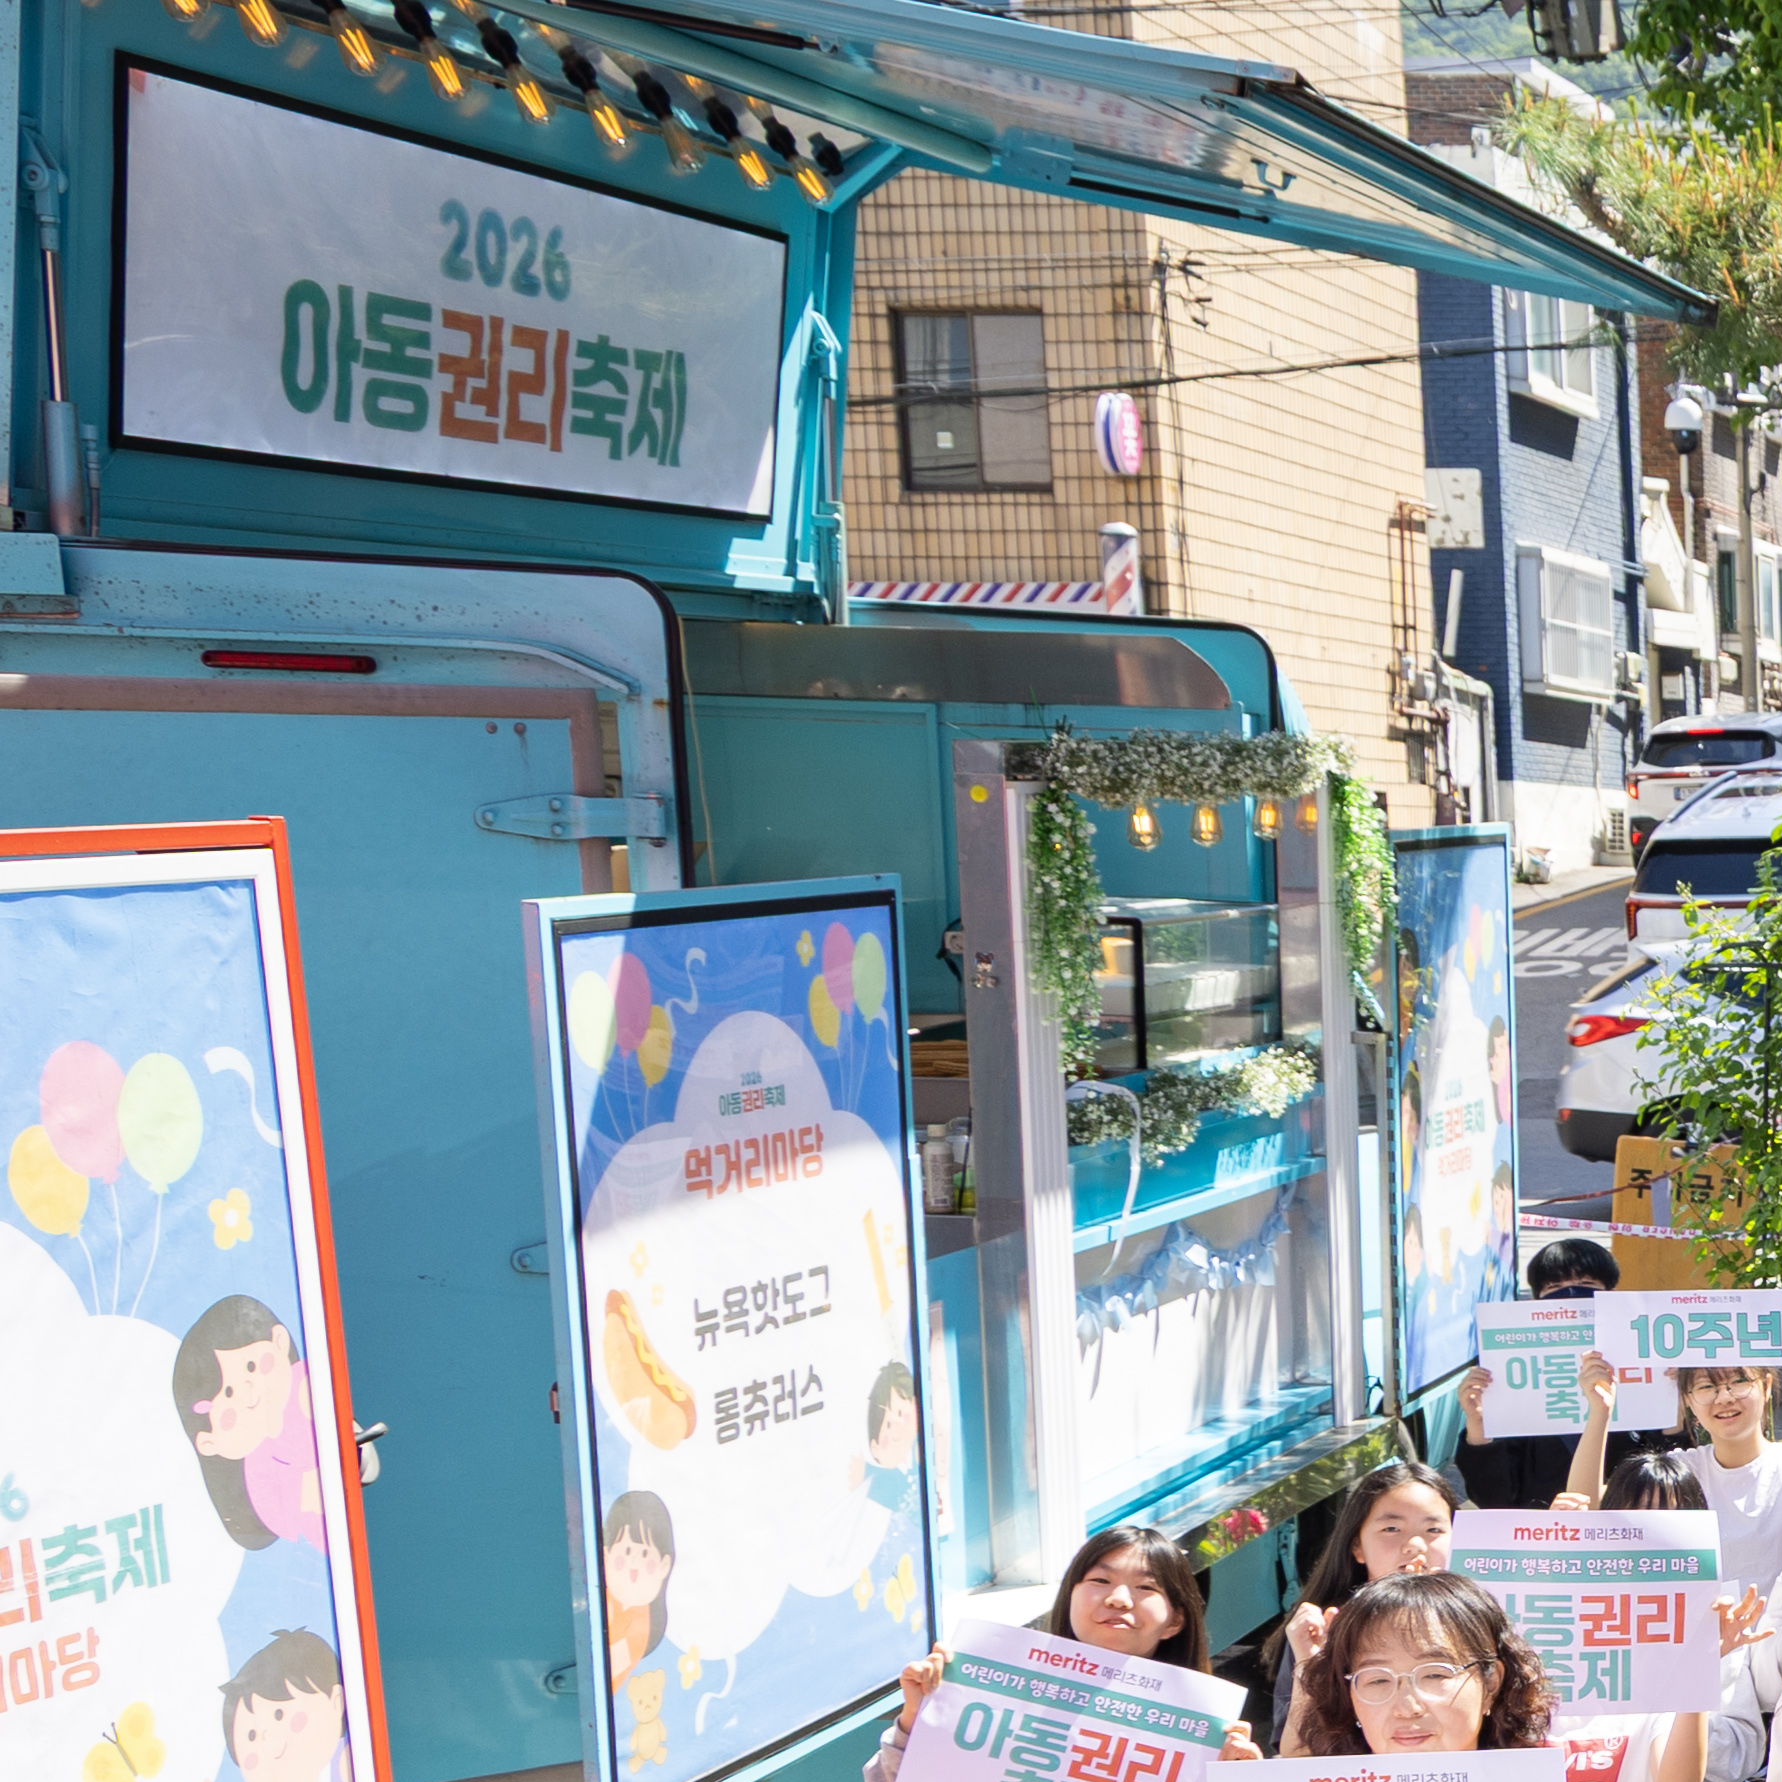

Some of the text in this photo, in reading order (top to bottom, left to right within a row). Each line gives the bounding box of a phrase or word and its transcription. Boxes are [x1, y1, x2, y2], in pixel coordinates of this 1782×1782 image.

[439, 198, 571, 302] 2026
[281, 278, 687, 468] 아동권리축제
[719, 1084, 786, 1116] 아동권리축제
[685, 1123, 823, 1200] 먹거리마당
[694, 1264, 831, 1352] 뉴욕핫도그
[1631, 1310, 1782, 1360] 10주년
[1671, 1293, 1708, 1305] meritz
[714, 1364, 824, 1445] 롱츄러스
